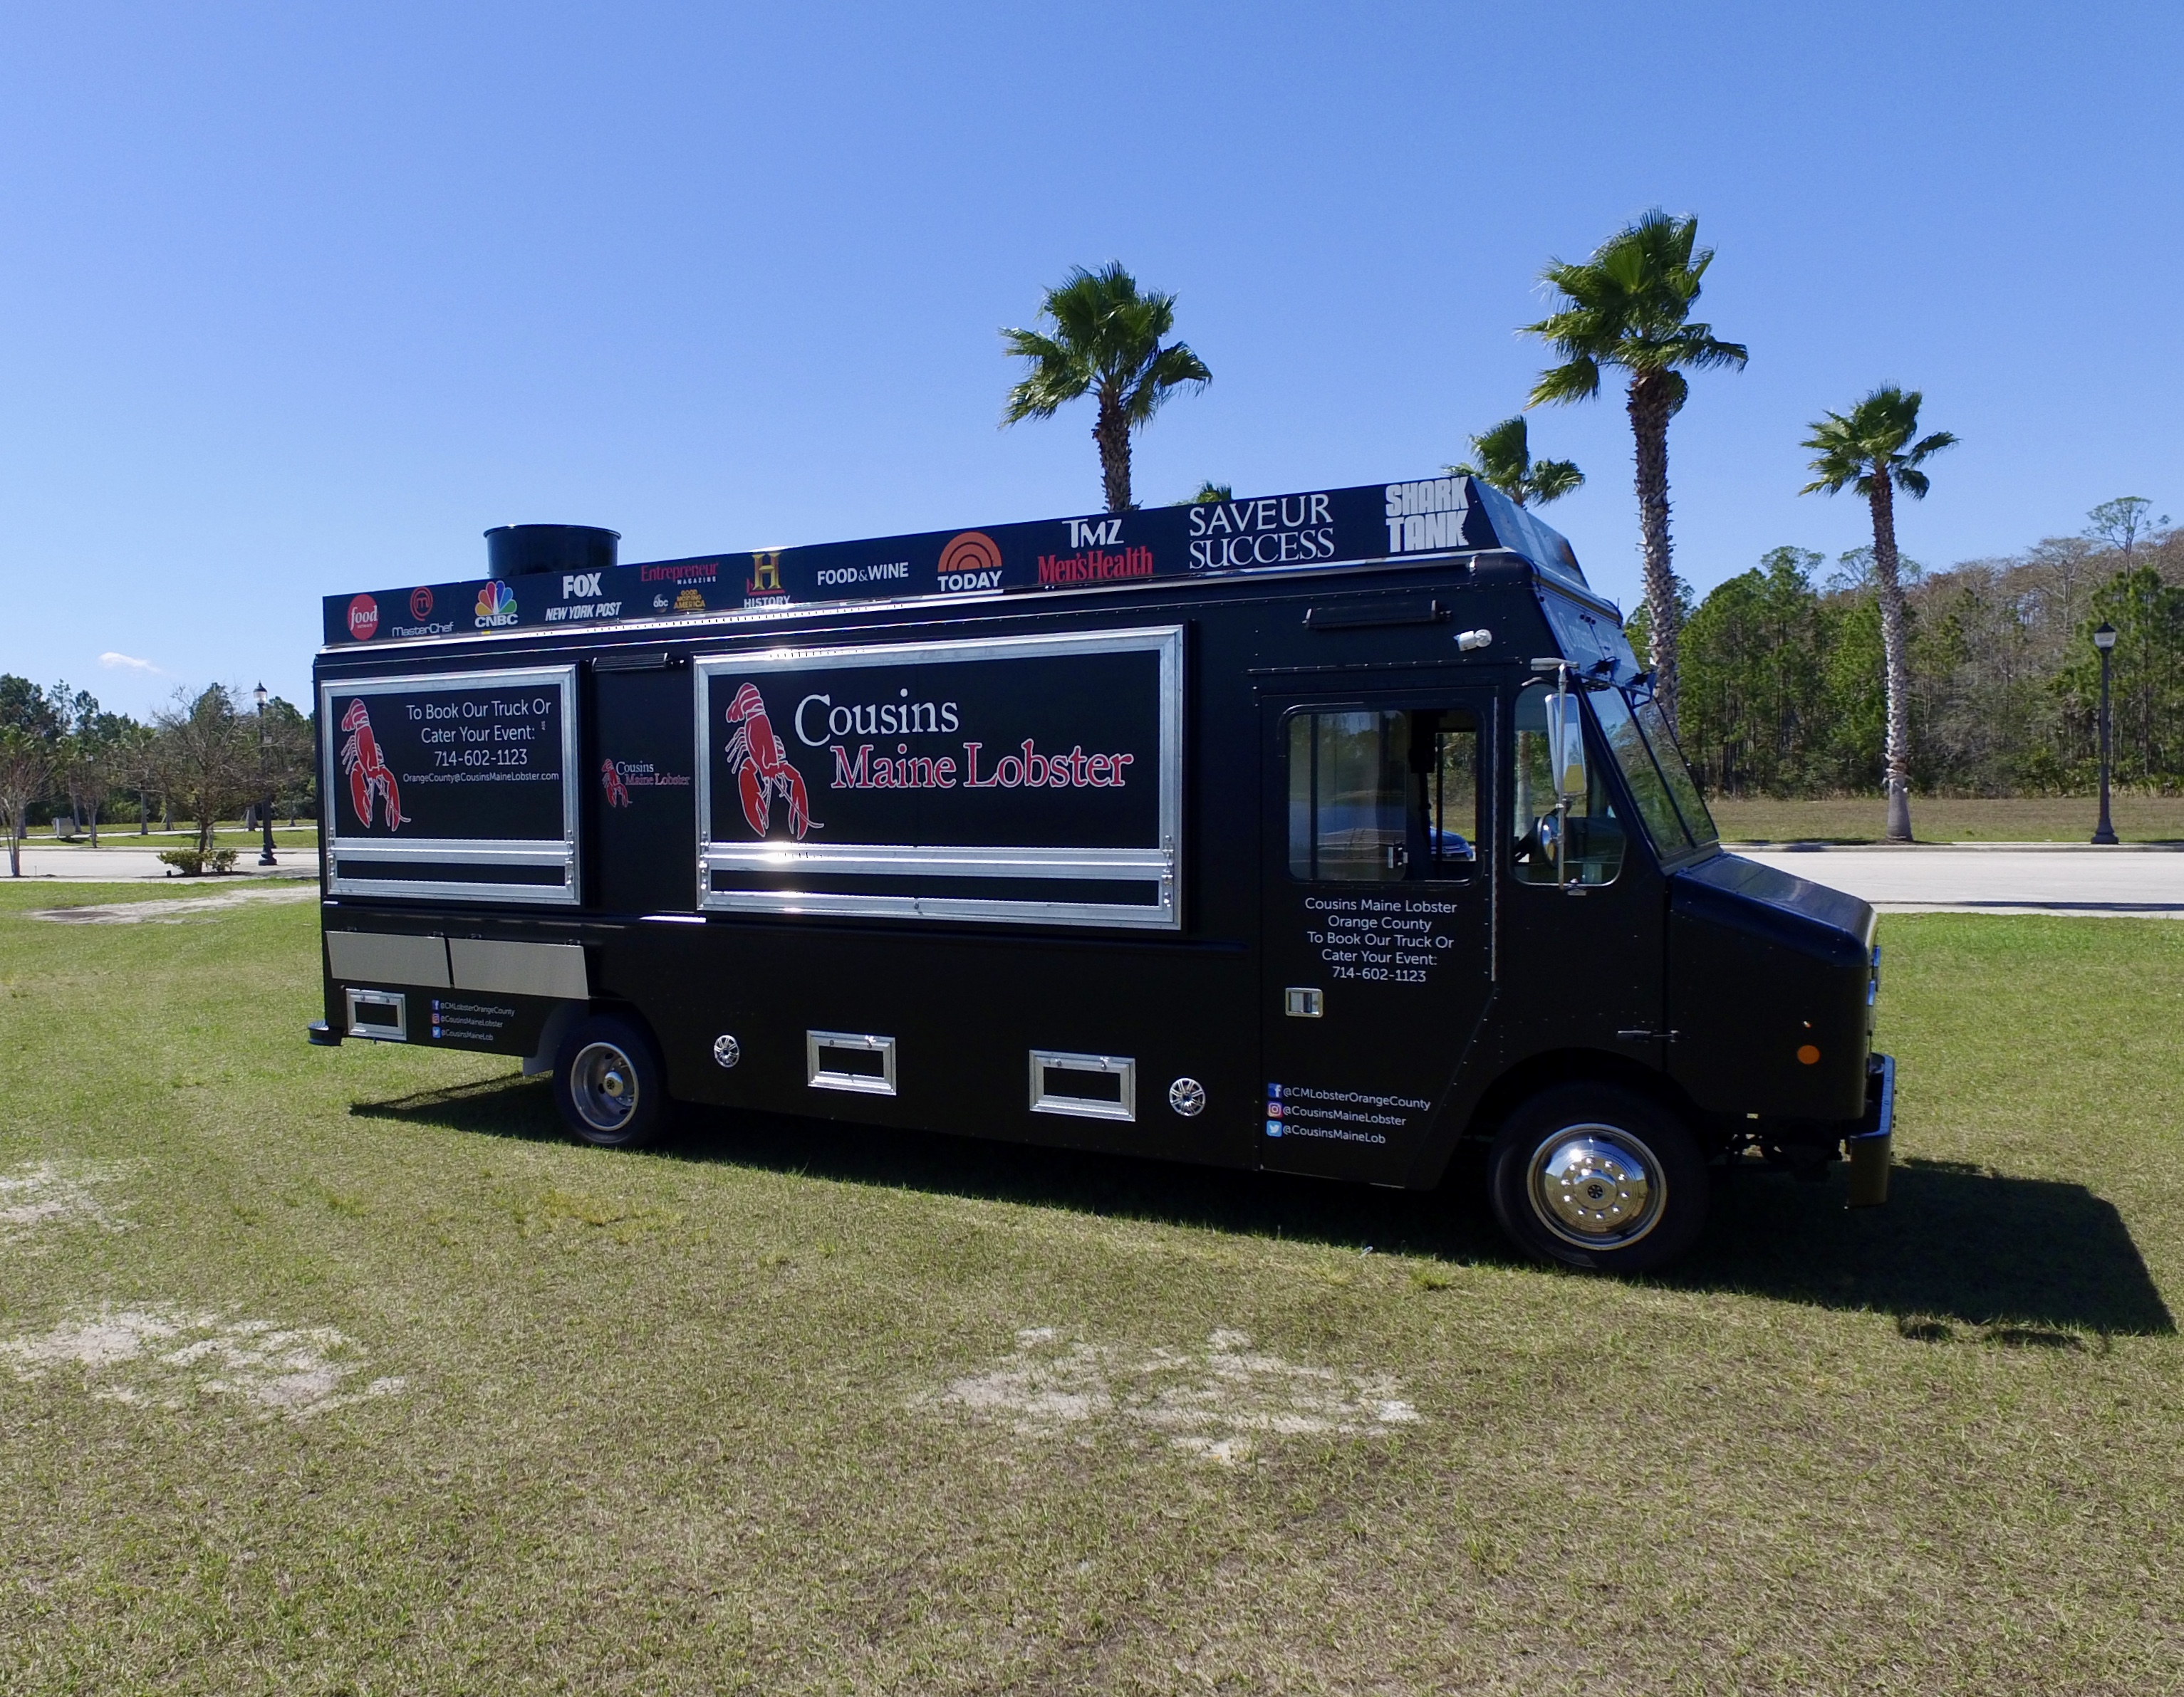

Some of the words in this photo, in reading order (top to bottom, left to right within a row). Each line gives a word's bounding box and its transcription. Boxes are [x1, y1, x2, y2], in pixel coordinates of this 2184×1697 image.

[1385, 476, 1469, 517] SHARK
[1190, 494, 1333, 536] SAVEUR
[1061, 518, 1124, 548] TMZ
[1385, 510, 1469, 553] TANK
[1190, 528, 1335, 570] SUCCESS
[641, 563, 719, 584] Entrepreneur
[677, 576, 717, 585] MAGAZINE
[937, 570, 1002, 592] TODAY
[563, 572, 602, 599] FOX
[653, 597, 669, 608] abc
[673, 600, 706, 610] AMERICA
[744, 595, 791, 608] HISTORY
[350, 605, 378, 631] food
[474, 613, 519, 629] CNBC
[545, 606, 568, 622] NEW
[568, 604, 596, 620] YORK
[596, 602, 622, 618] POST
[406, 705, 422, 721] To
[426, 703, 459, 720] Book
[462, 701, 488, 718] Our
[492, 699, 529, 716] Truck
[533, 698, 551, 714] Or
[794, 688, 960, 747] Cousins
[421, 728, 456, 743] Cater
[459, 726, 489, 742] Your
[494, 725, 536, 741] Event:
[435, 748, 528, 767] 714-602-1123
[830, 743, 957, 789] Maine
[962, 738, 1134, 788] Lobster
[402, 771, 559, 784] OrangeCounty@CousinsMaineLobster.com
[615, 761, 654, 776] Cousins
[625, 773, 654, 785] Maine
[655, 773, 690, 785] Lobster
[1304, 897, 1357, 911] Cousins
[1361, 899, 1401, 912] Maine
[1405, 900, 1457, 914] Lobster
[1328, 915, 1378, 931] Orange
[1381, 917, 1432, 933] County
[1307, 931, 1323, 944] To
[1327, 932, 1361, 945] Book
[1365, 933, 1391, 946] Our
[1394, 934, 1432, 948] Truck
[1435, 936, 1455, 949] Or
[1321, 949, 1358, 961] Cater
[1361, 950, 1392, 963] Your
[1395, 952, 1437, 966] Event:
[1332, 966, 1427, 982] 714-602-1123
[440, 1001, 515, 1017] @CMLobsterOrangeCounty
[440, 1015, 504, 1028] @CousinsMaineLobster
[441, 1029, 494, 1041] @CousinsMaineLob
[1283, 1087, 1431, 1111] @CMLobsterOrangeCounty
[1283, 1106, 1407, 1126] @CousinsMaineLobster
[1283, 1125, 1386, 1144] @CousinsMaineLob
